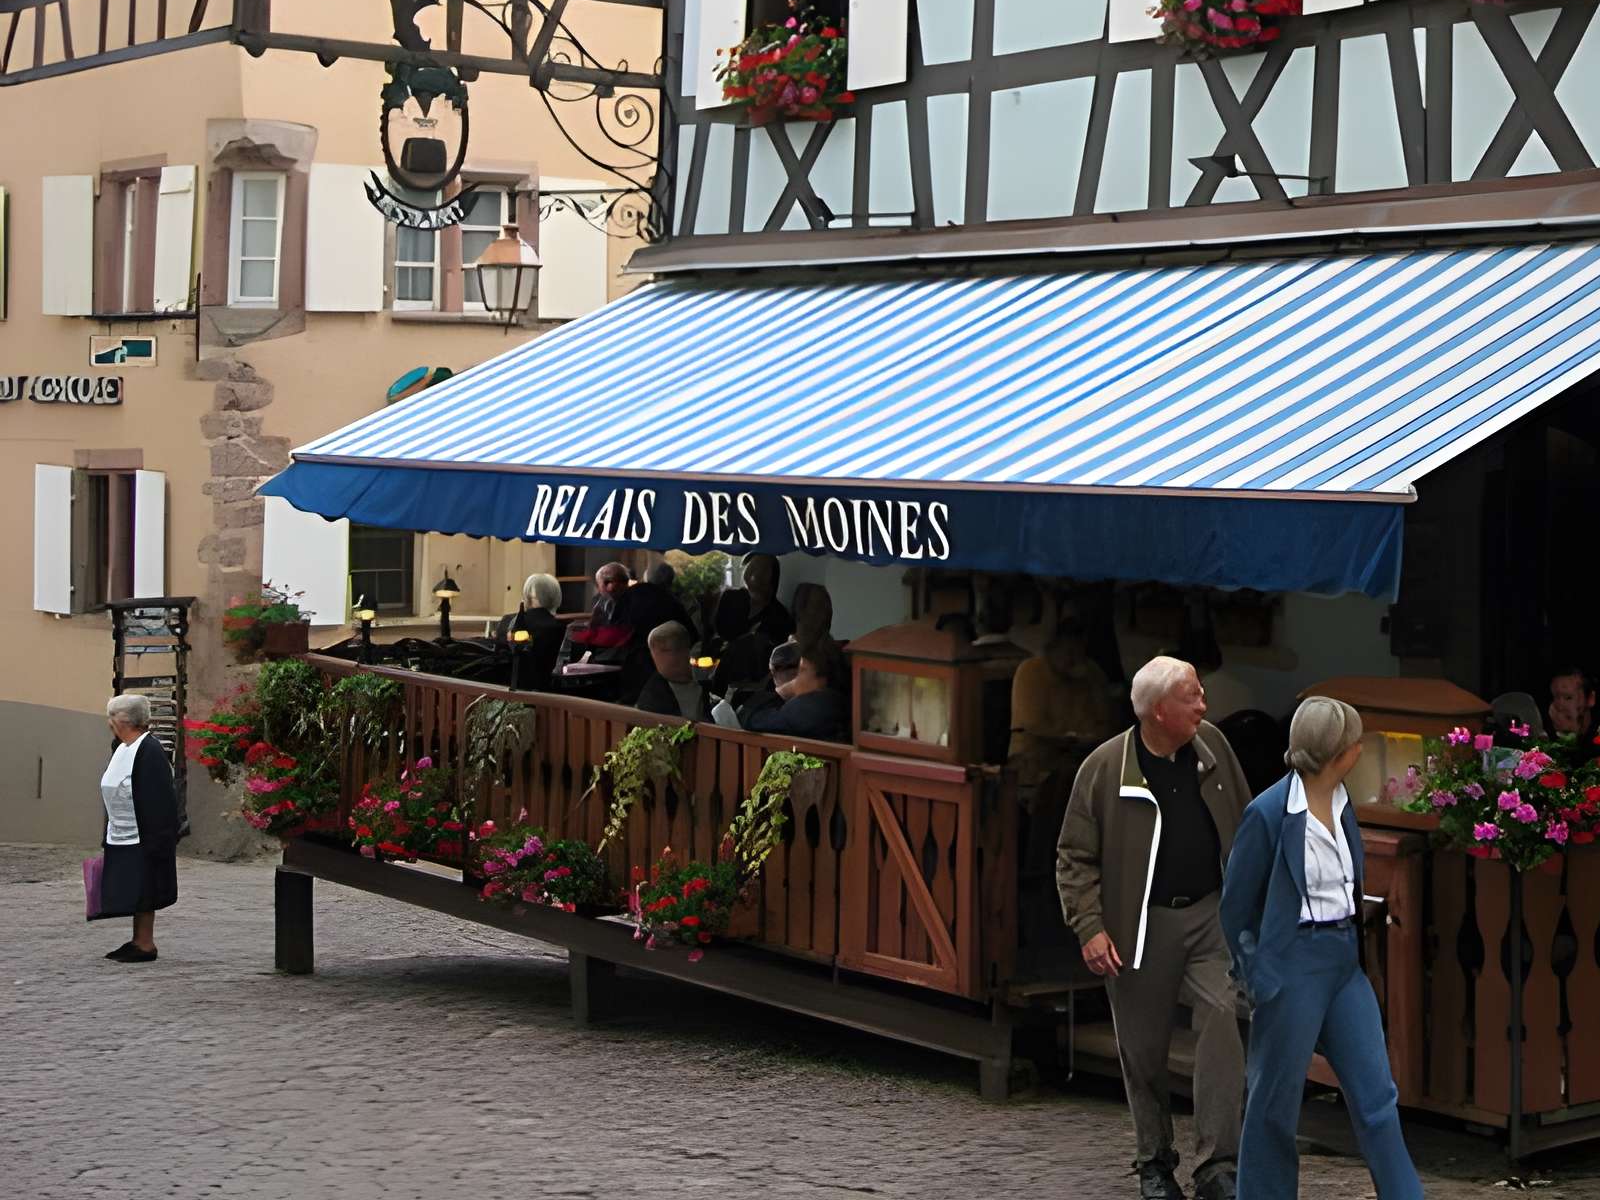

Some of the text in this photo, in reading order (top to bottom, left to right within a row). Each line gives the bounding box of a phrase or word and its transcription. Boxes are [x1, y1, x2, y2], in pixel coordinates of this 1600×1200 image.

[525, 484, 950, 561] RELAIS DES MOINES
